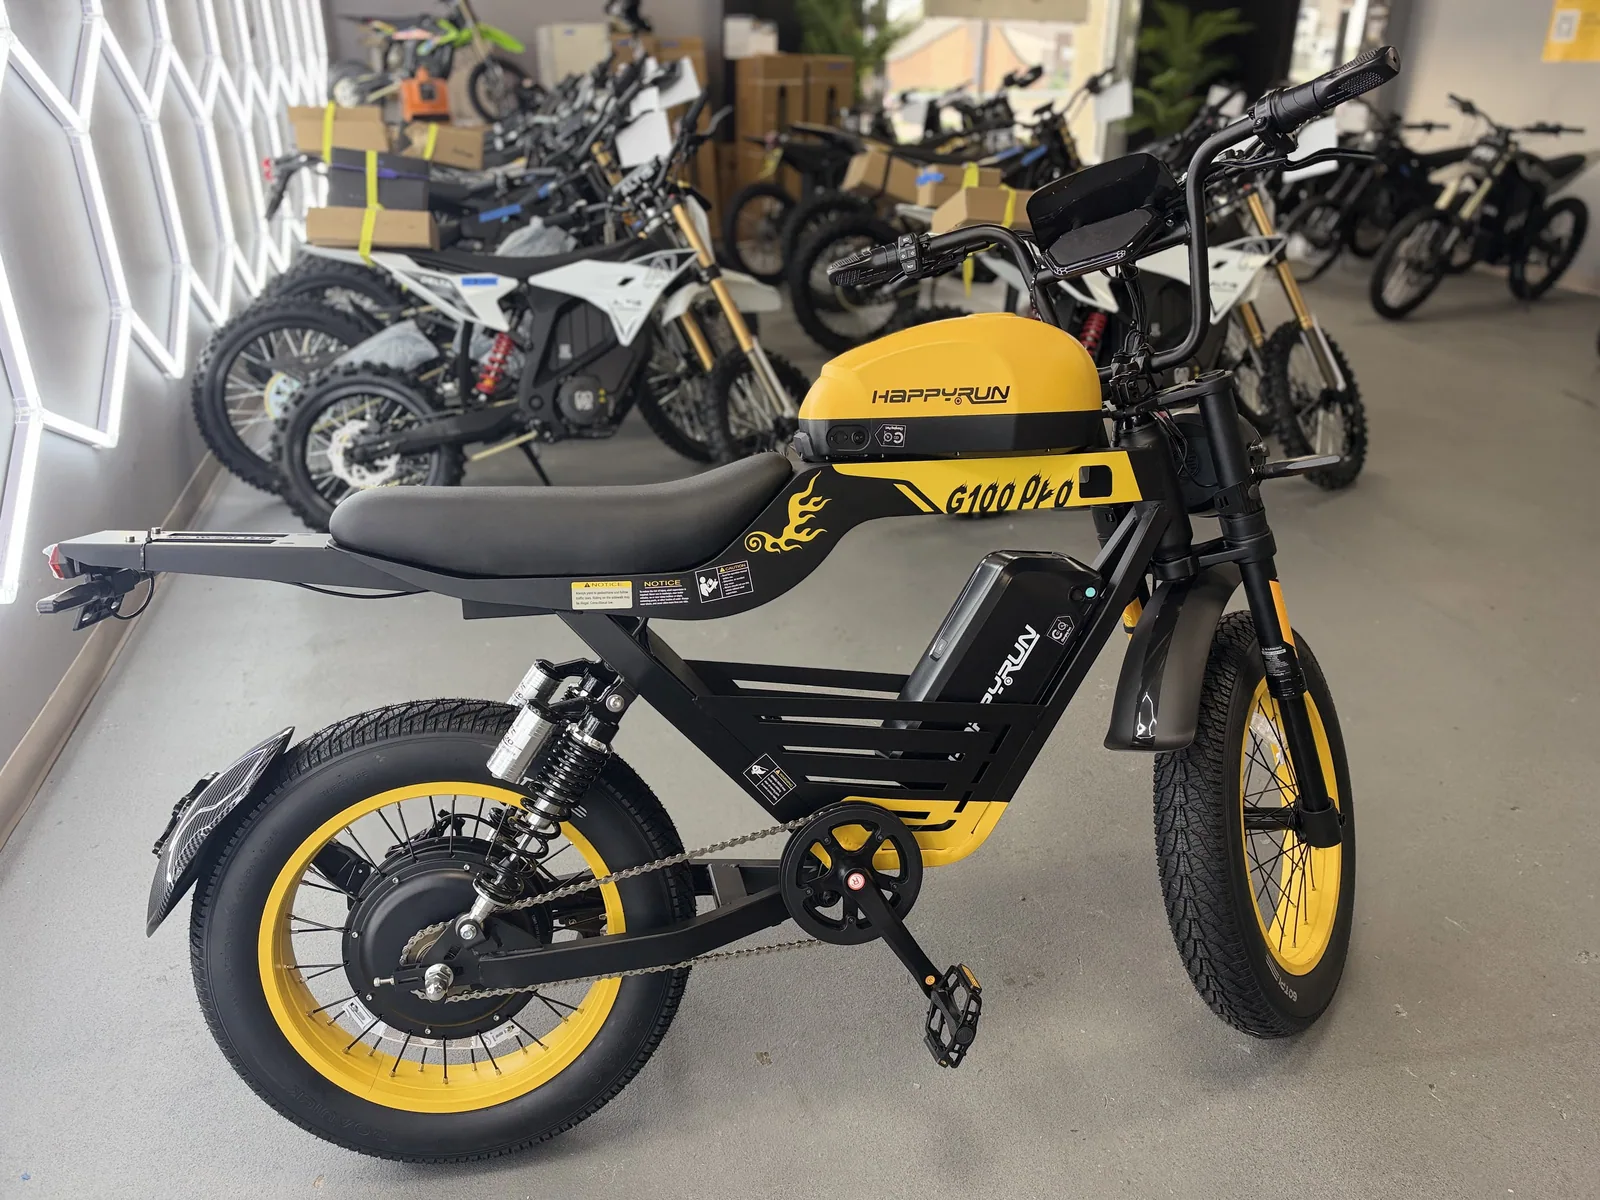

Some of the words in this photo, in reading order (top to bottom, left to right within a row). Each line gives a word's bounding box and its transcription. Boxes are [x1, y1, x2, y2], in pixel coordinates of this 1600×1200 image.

[871, 385, 1011, 406] HAPPYRUN
[945, 476, 1018, 515] G100
[724, 563, 747, 571] CAUTION
